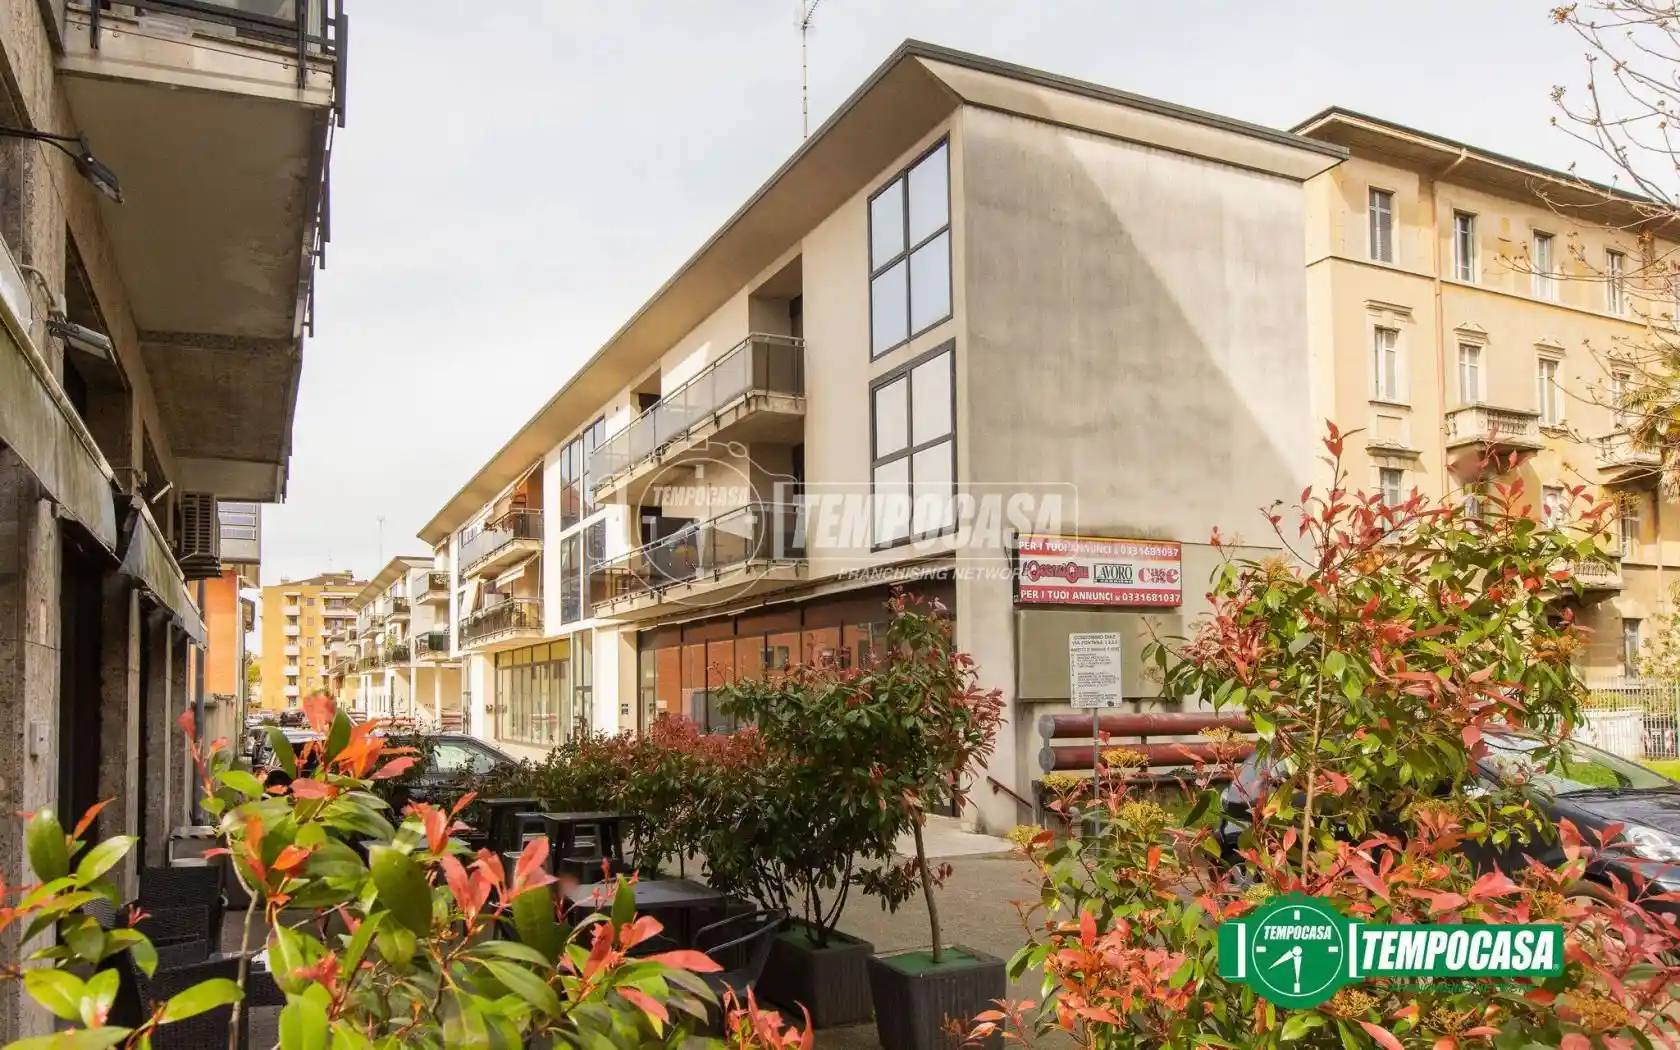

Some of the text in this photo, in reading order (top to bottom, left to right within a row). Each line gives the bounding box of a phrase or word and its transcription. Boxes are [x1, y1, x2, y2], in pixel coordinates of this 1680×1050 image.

[1019, 541, 1038, 550] PER
[1093, 564, 1133, 580] LAVORO
[1020, 590, 1039, 599] PER
[1047, 591, 1070, 600] TUOI
[1072, 591, 1113, 601] ANNUNCI
[1122, 594, 1181, 603] 0331681037
